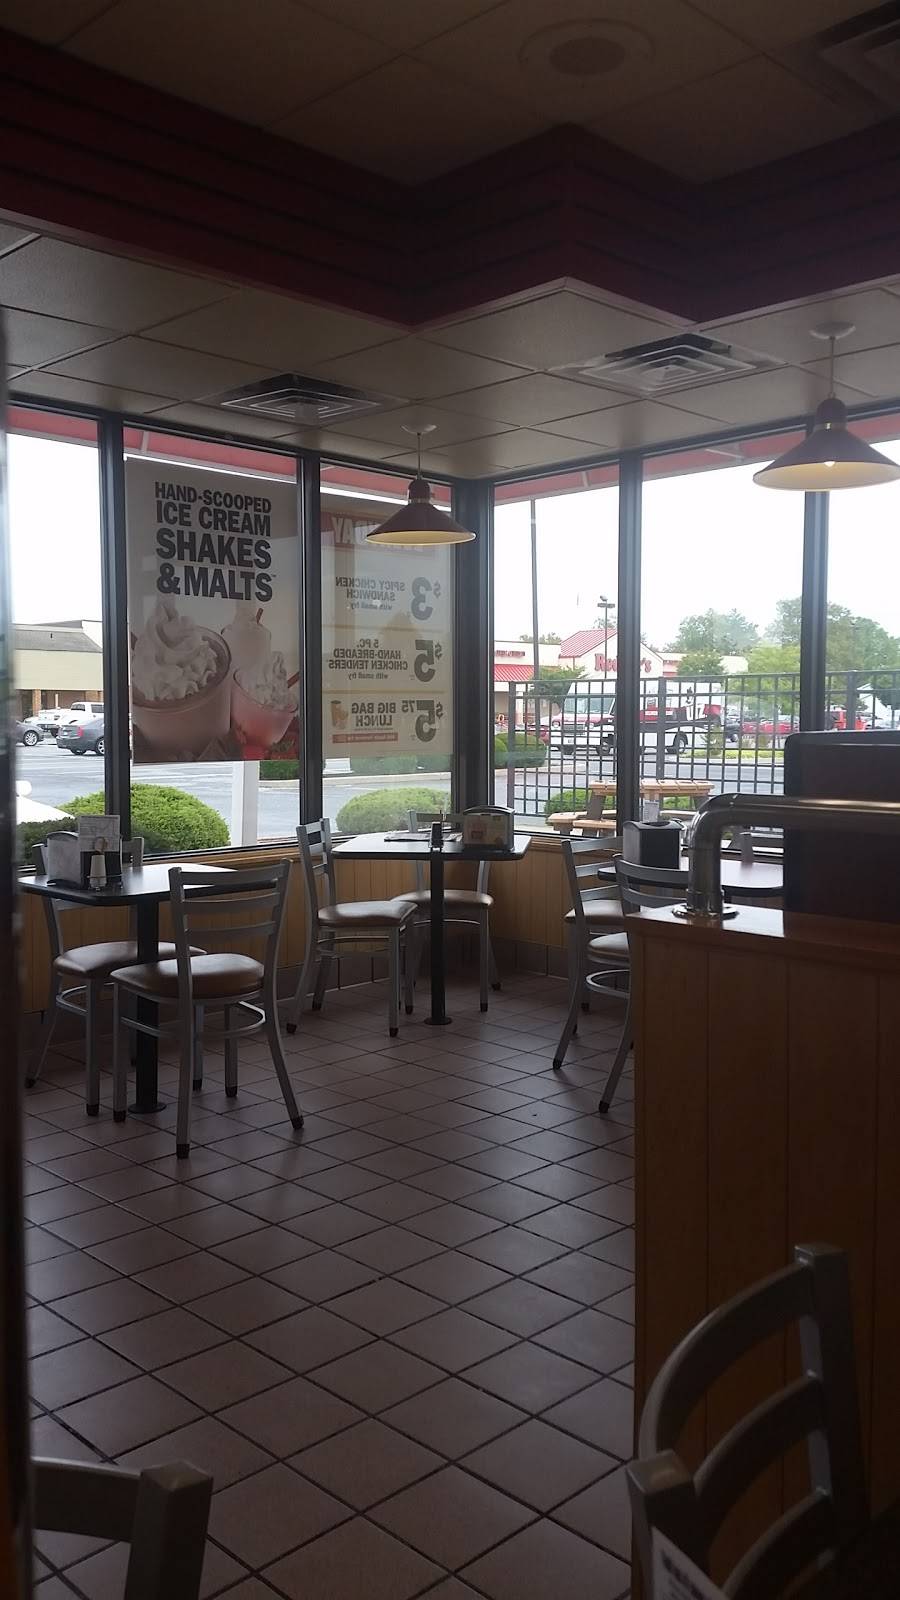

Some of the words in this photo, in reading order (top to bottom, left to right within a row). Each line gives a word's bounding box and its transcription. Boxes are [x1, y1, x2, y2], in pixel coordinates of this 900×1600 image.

[154, 481, 272, 514] HAND-SCOOPED
[156, 500, 192, 527] ICE
[198, 507, 271, 537] CREAM
[156, 528, 272, 569] SHAKES
[156, 562, 181, 595] &
[184, 565, 273, 602] MALTS
